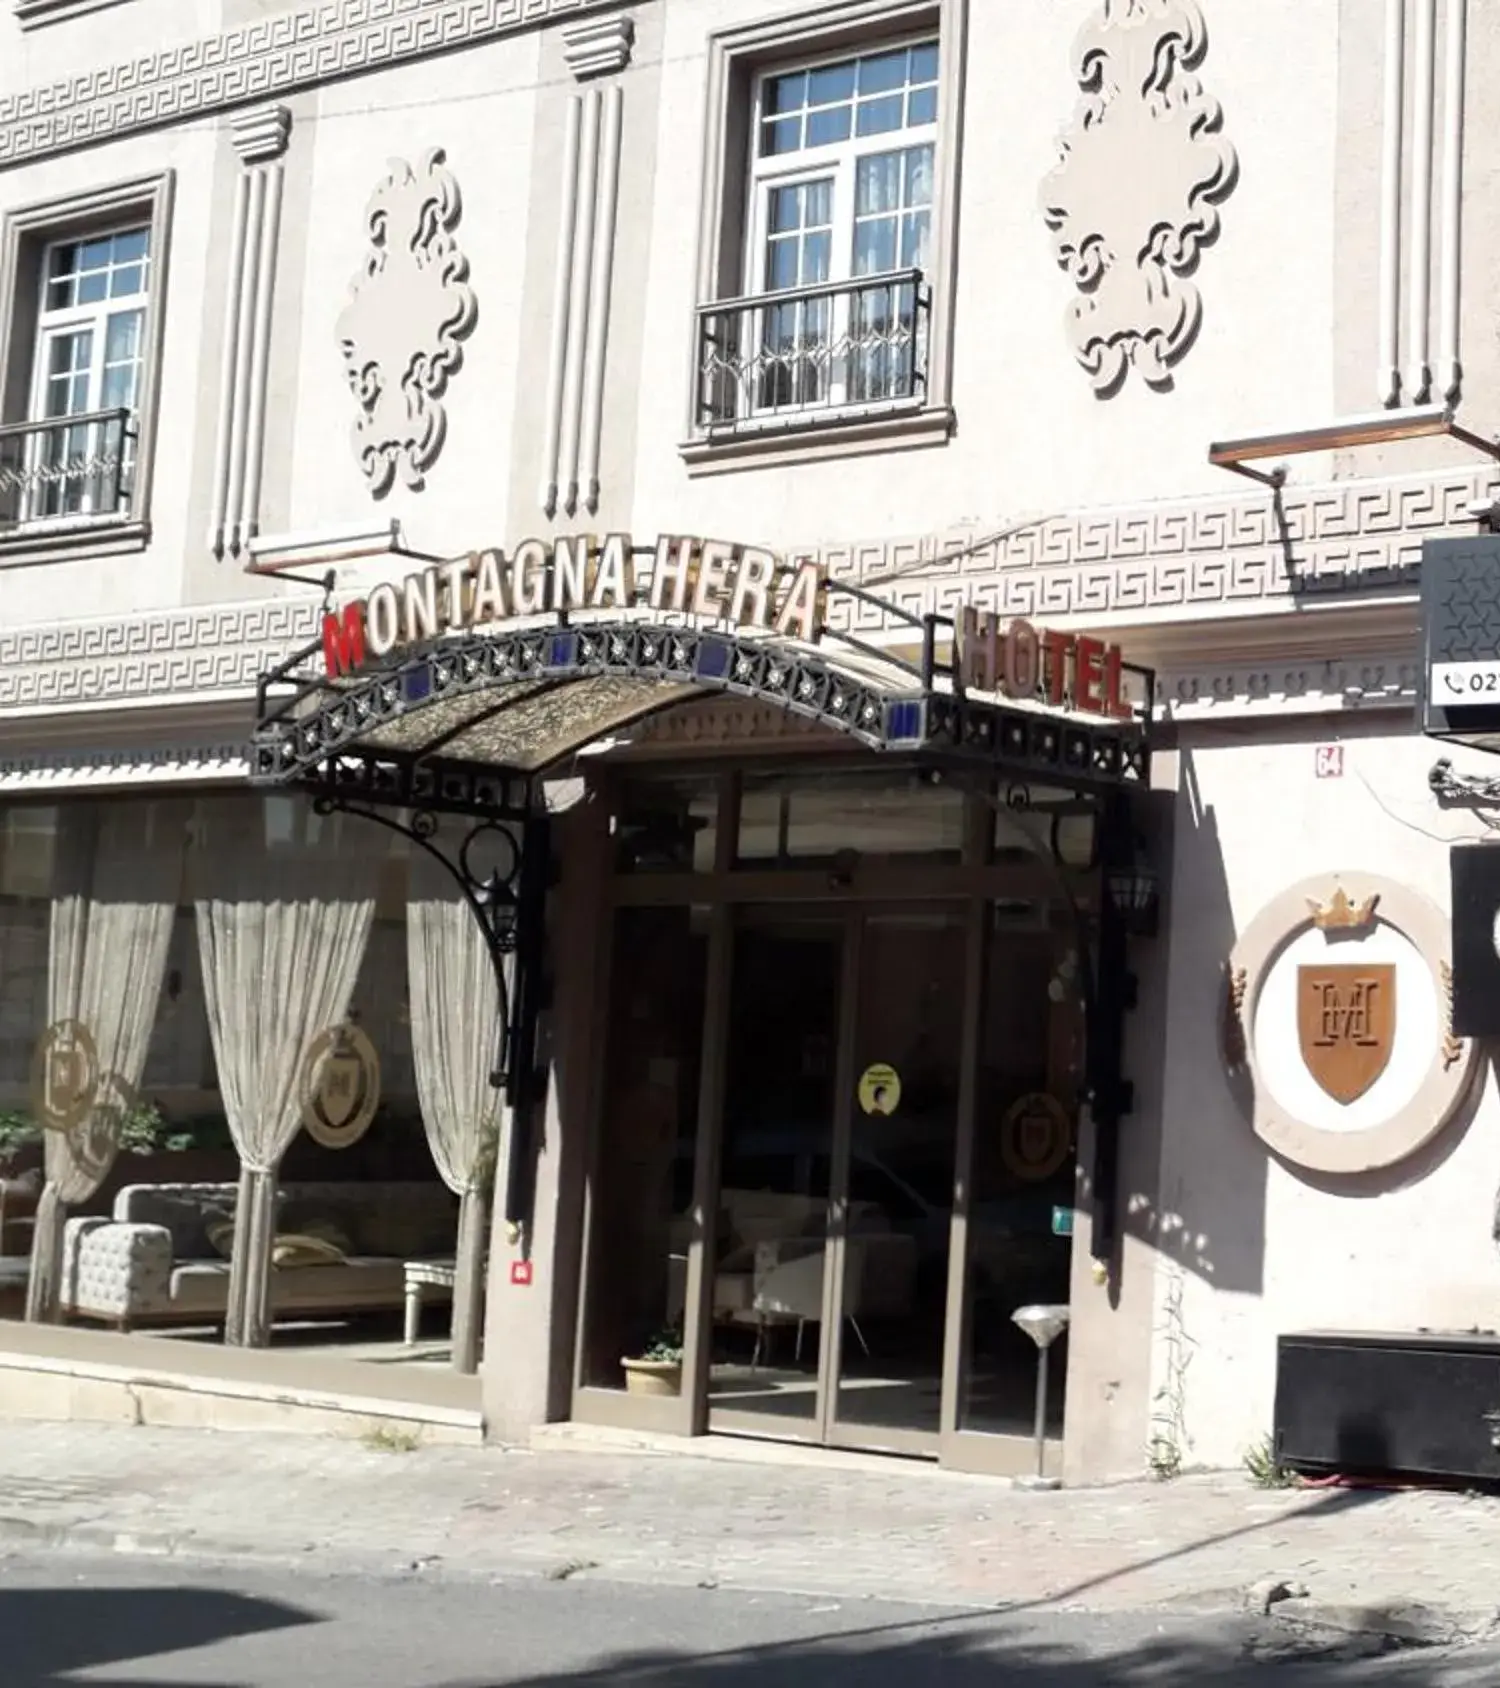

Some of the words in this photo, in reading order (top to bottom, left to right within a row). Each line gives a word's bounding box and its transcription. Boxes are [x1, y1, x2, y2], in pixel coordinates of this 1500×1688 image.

[321, 531, 633, 683] MONTAGNA
[649, 532, 826, 645] HERA
[953, 603, 1135, 720] HOTEL
